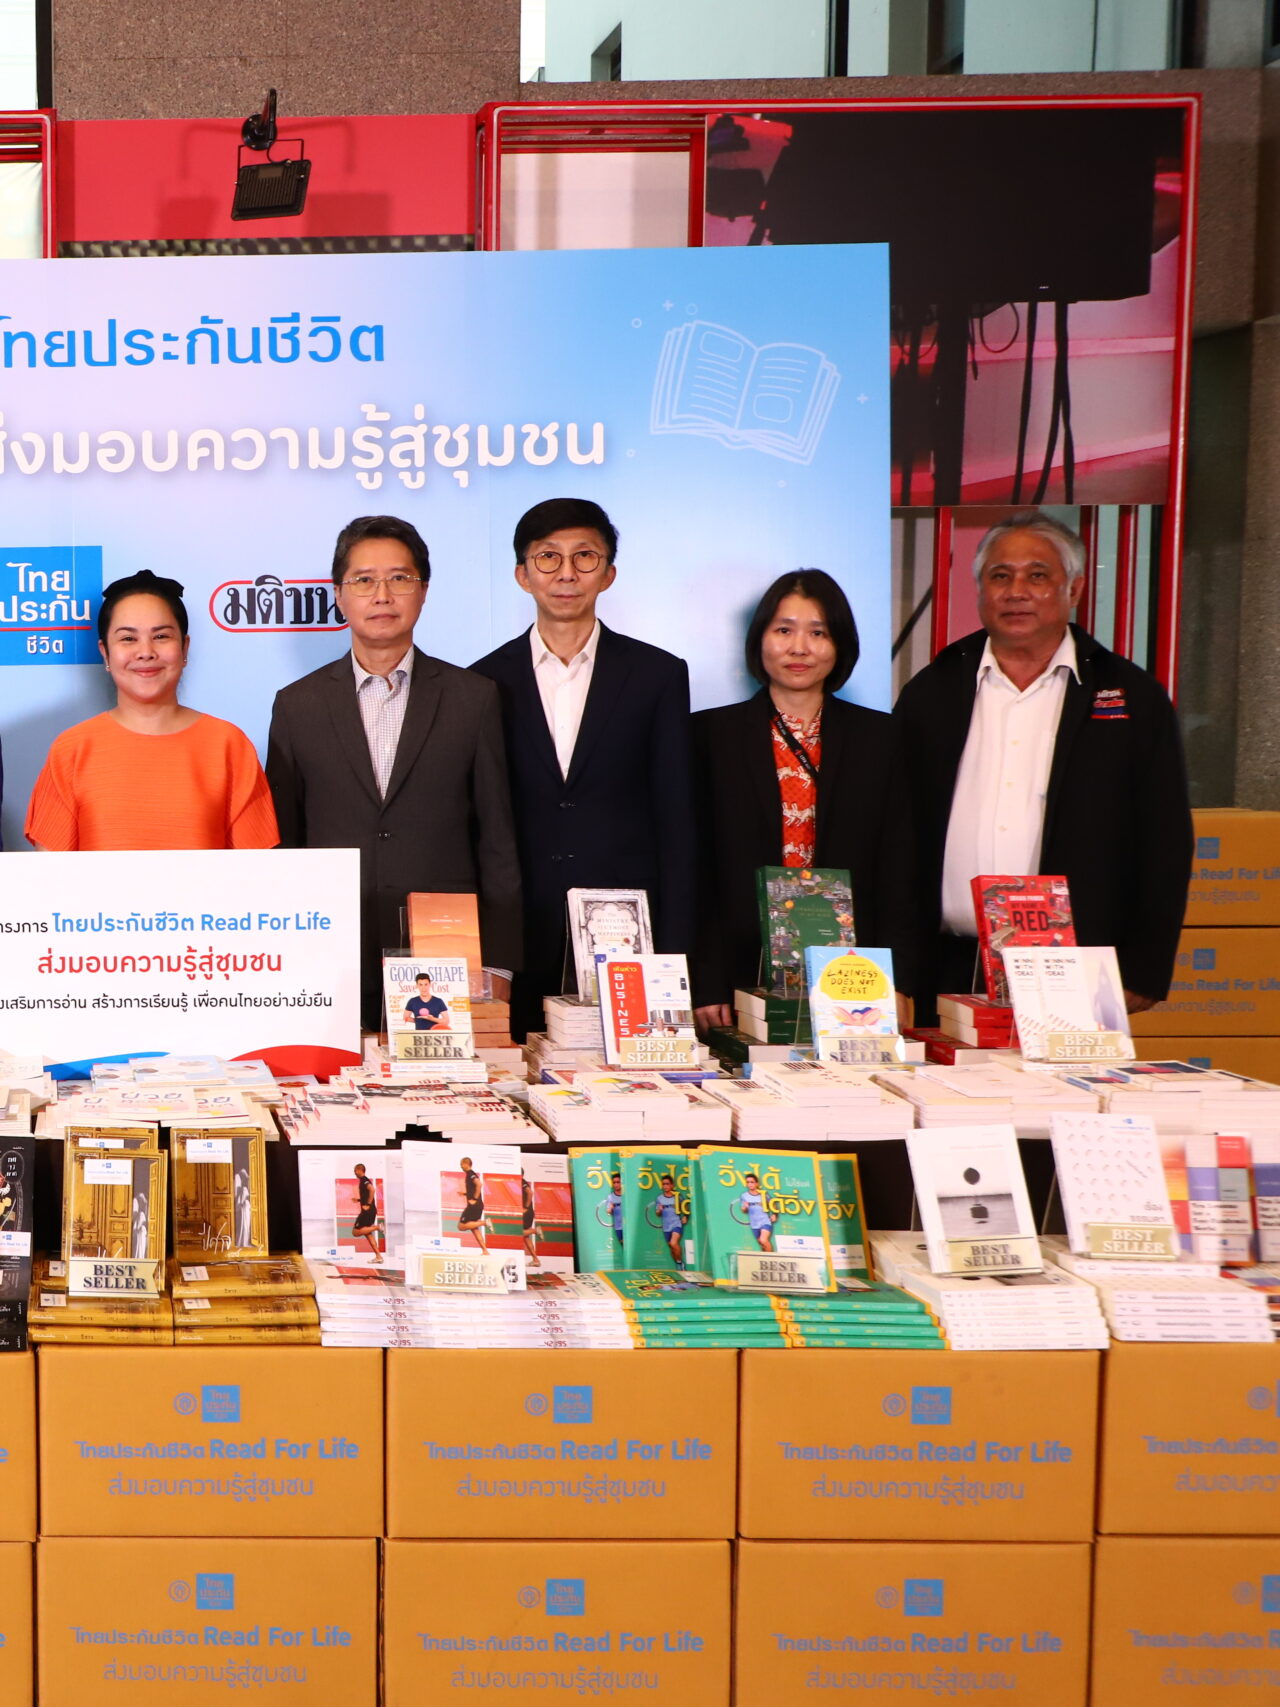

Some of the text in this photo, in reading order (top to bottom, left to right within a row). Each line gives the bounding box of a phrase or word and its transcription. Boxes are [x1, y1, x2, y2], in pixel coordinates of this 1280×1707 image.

[6, 562, 70, 593] ไทย
[26, 635, 65, 654] ชีวิต
[52, 912, 194, 933] ไทยประกันชีวิต
[200, 912, 254, 931] Read
[257, 912, 294, 931] For
[296, 911, 332, 931] Life
[37, 947, 282, 980] ส่งมอบความรู้สู่ชุมชน
[427, 966, 465, 982] SHAPE
[431, 983, 449, 993] Cost
[91, 993, 189, 1013] สร้างการเรียนรู้
[192, 990, 333, 1008] เพื่อคนไทยอย่างยั่งยืน
[412, 1035, 453, 1046] BEST
[636, 1040, 677, 1051] BEST
[838, 1039, 881, 1051] BEST
[1064, 1034, 1106, 1046] BEST
[404, 1047, 463, 1058] SELLER
[627, 1052, 688, 1063] SELLER
[830, 1051, 893, 1063] SELLER
[1055, 1046, 1117, 1058] SELLER
[1111, 1229, 1155, 1241] BEST
[971, 1244, 1010, 1256] BEST
[1103, 1241, 1165, 1254] SELLER
[759, 1260, 800, 1272] BEST
[963, 1254, 1020, 1267] SELLER
[93, 1264, 136, 1277] BEST
[443, 1261, 487, 1274] BEST
[83, 1276, 146, 1290] SELLER
[434, 1273, 496, 1286] SELLER
[751, 1271, 808, 1284] SELLER
[209, 1436, 267, 1460] Read
[274, 1438, 313, 1460] For
[317, 1436, 361, 1460] Life
[559, 1437, 619, 1461] Read
[625, 1439, 665, 1461] For
[670, 1437, 713, 1461] Life
[916, 1439, 978, 1463] Read
[984, 1440, 1025, 1463] For
[1029, 1439, 1073, 1464] Life
[107, 1472, 315, 1502] ส่งมอบความรู้สู่ชุมชน
[202, 1624, 261, 1647] Read
[267, 1626, 306, 1647] For
[311, 1624, 353, 1648] Life
[552, 1630, 612, 1653] Read
[618, 1631, 657, 1653] For
[662, 1629, 705, 1653] Life
[909, 1631, 971, 1654] Read
[975, 1631, 1016, 1654] For
[1020, 1631, 1064, 1654] Life
[102, 1658, 308, 1688] ส่งมอบความรู้สู่ชุมชน
